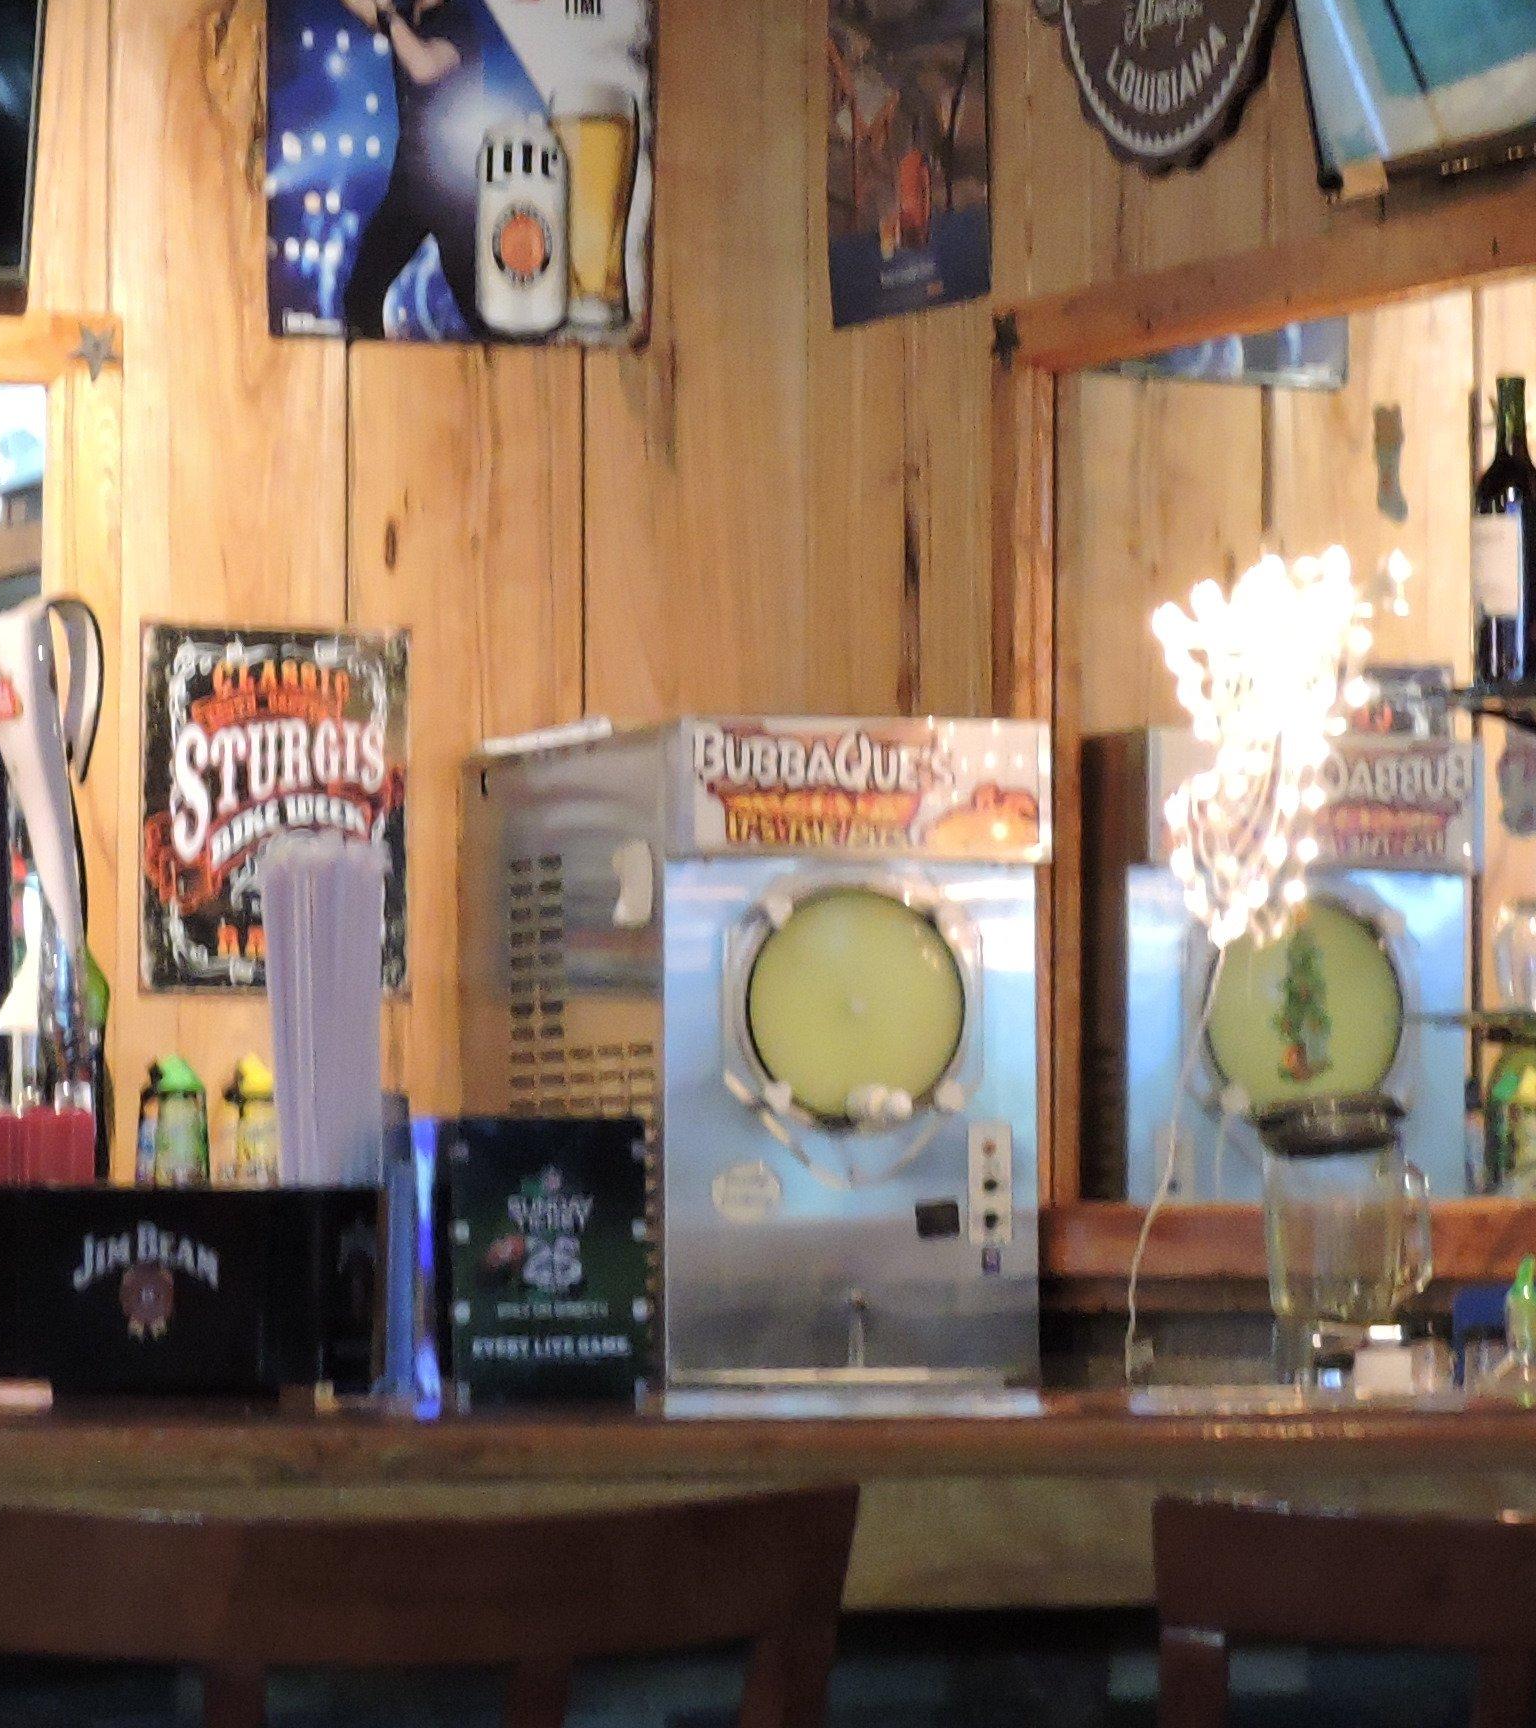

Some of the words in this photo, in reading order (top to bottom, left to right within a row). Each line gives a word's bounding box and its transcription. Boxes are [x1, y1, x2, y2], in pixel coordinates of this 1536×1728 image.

[171, 714, 386, 866] STURGIS
[72, 1231, 131, 1292] JIM
[136, 1219, 220, 1291] BEAM
